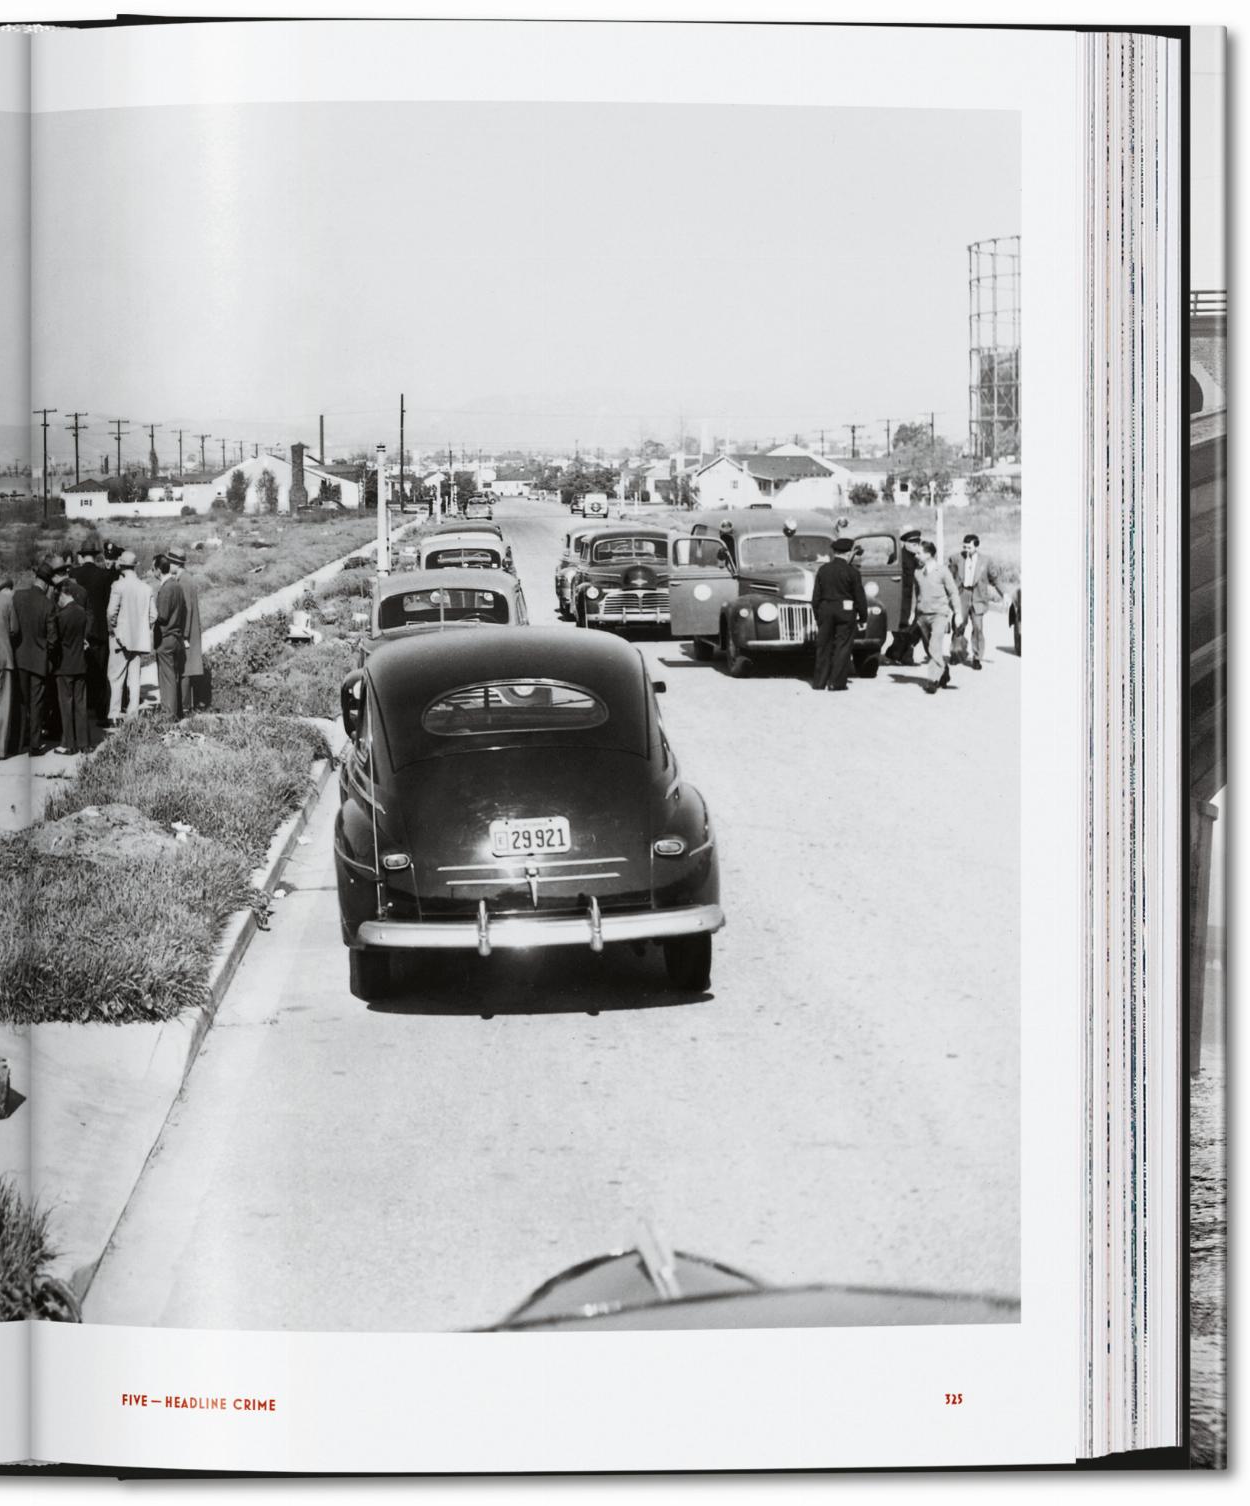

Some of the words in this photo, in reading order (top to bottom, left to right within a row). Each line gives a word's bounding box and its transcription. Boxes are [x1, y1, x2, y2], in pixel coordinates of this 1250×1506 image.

[122, 1394, 147, 1406] FIVE
[166, 1396, 226, 1409] HEADLINE
[233, 1399, 275, 1411] CRIME
[945, 1394, 963, 1404] 325
